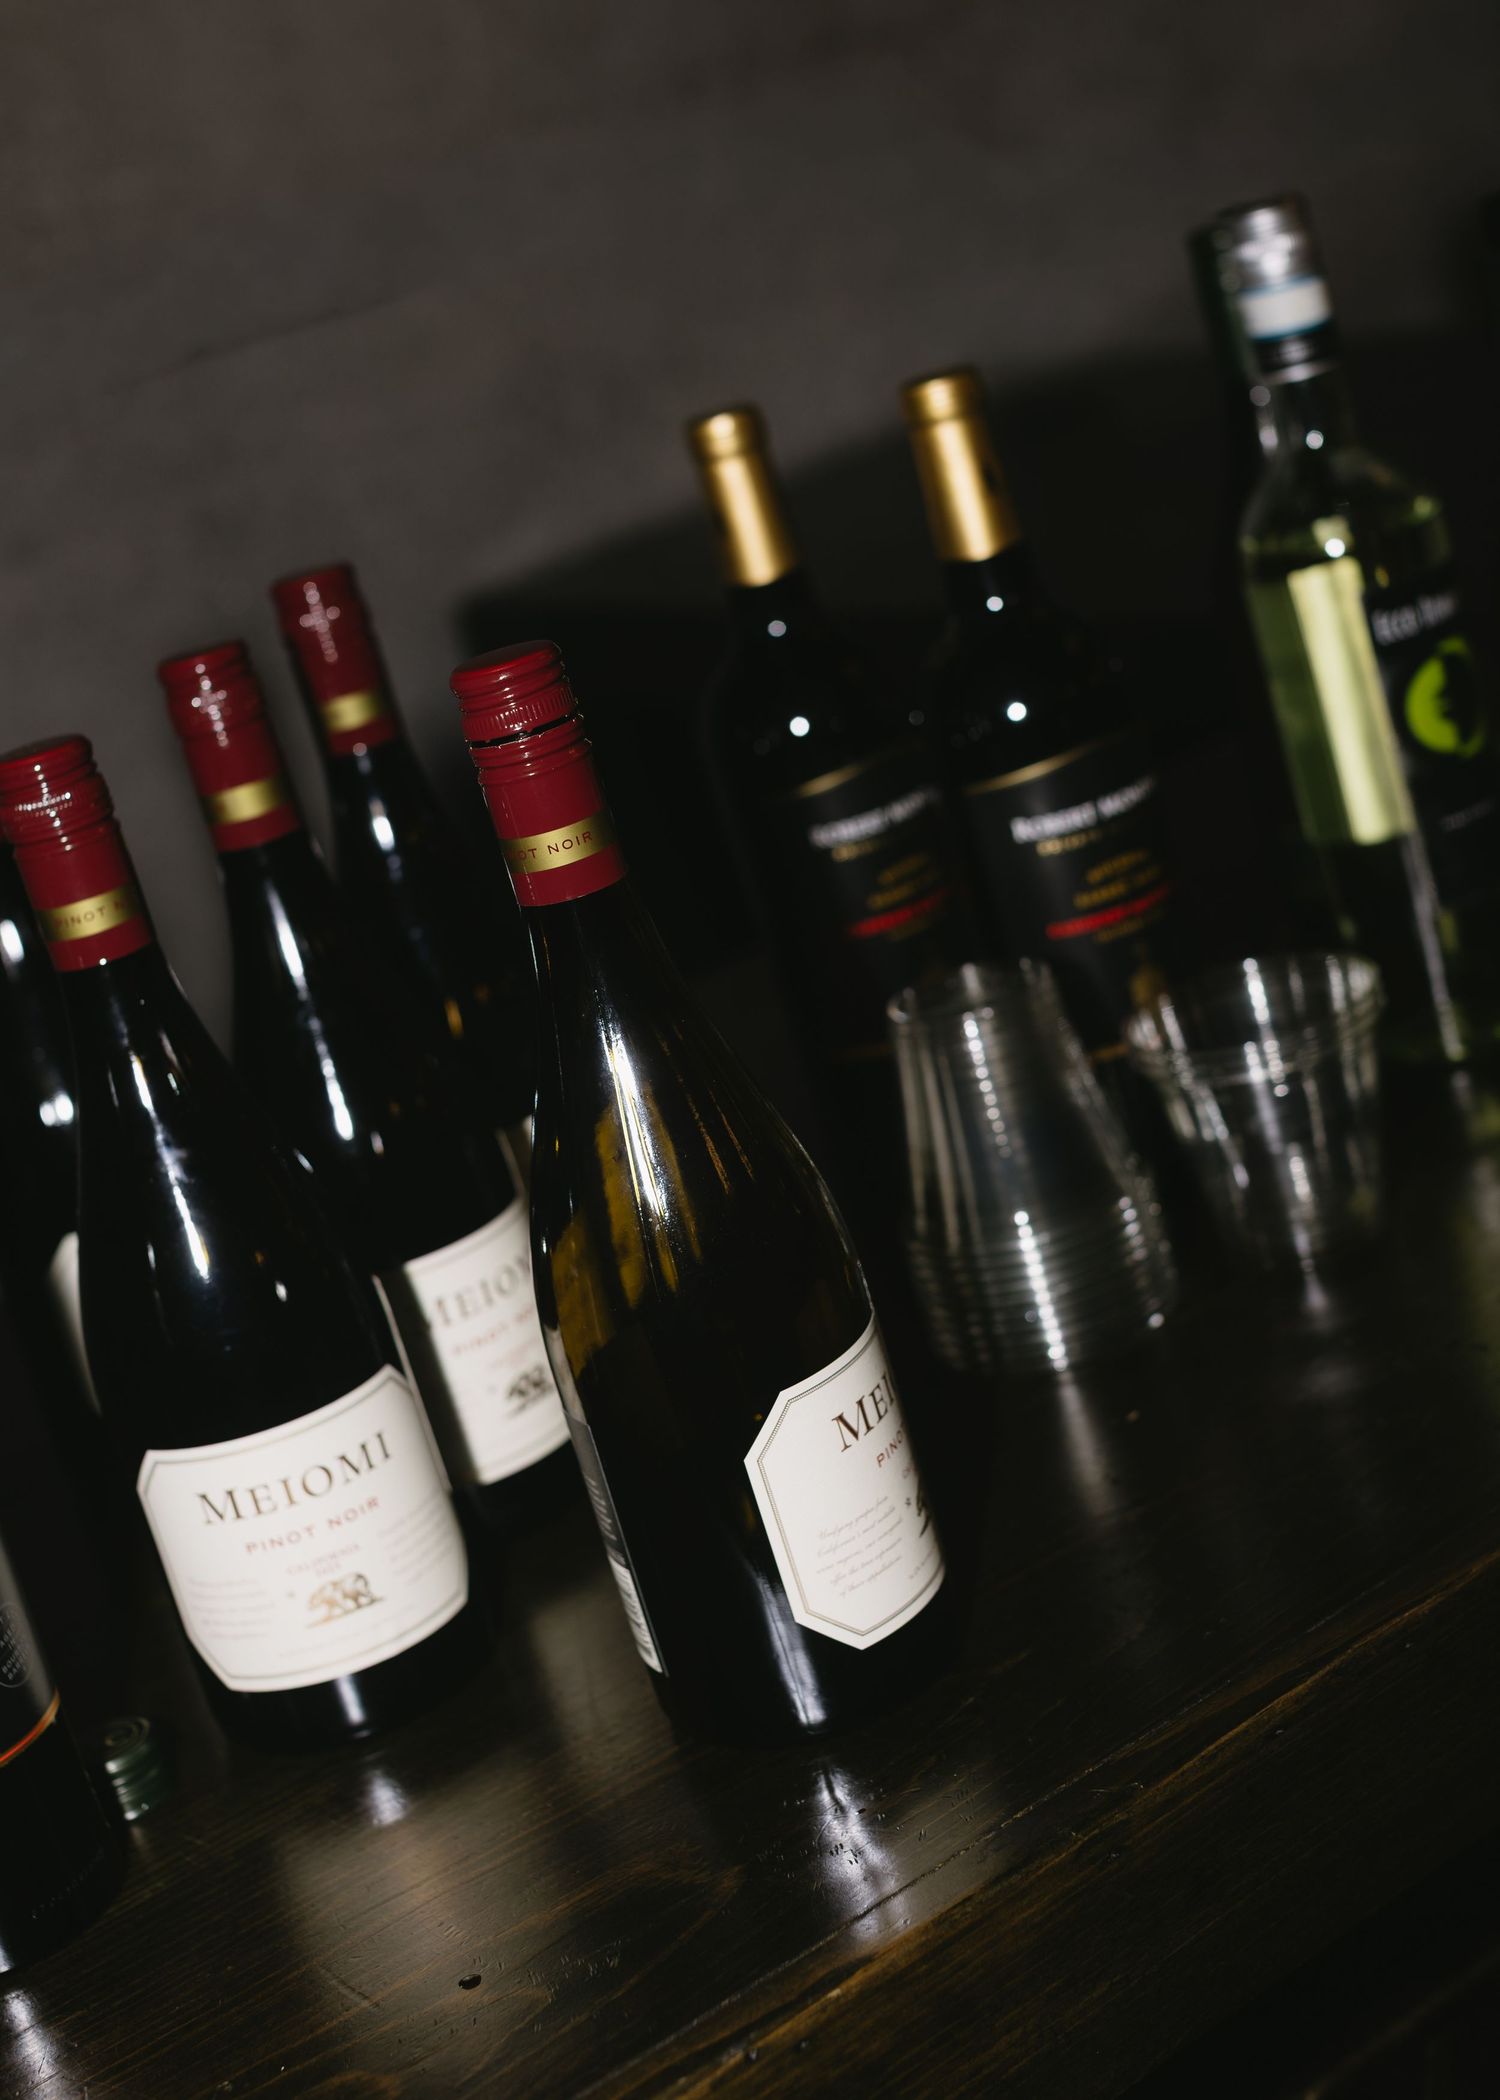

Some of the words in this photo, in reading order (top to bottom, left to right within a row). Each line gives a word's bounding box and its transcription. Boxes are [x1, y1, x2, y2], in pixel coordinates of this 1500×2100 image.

[546, 831, 594, 856] NOIR
[832, 1371, 896, 1453] MEI
[196, 1430, 394, 1525] MEIOMI
[876, 1428, 906, 1468] PINO
[245, 1526, 318, 1555] PINOT
[327, 1495, 381, 1530] NOIR
